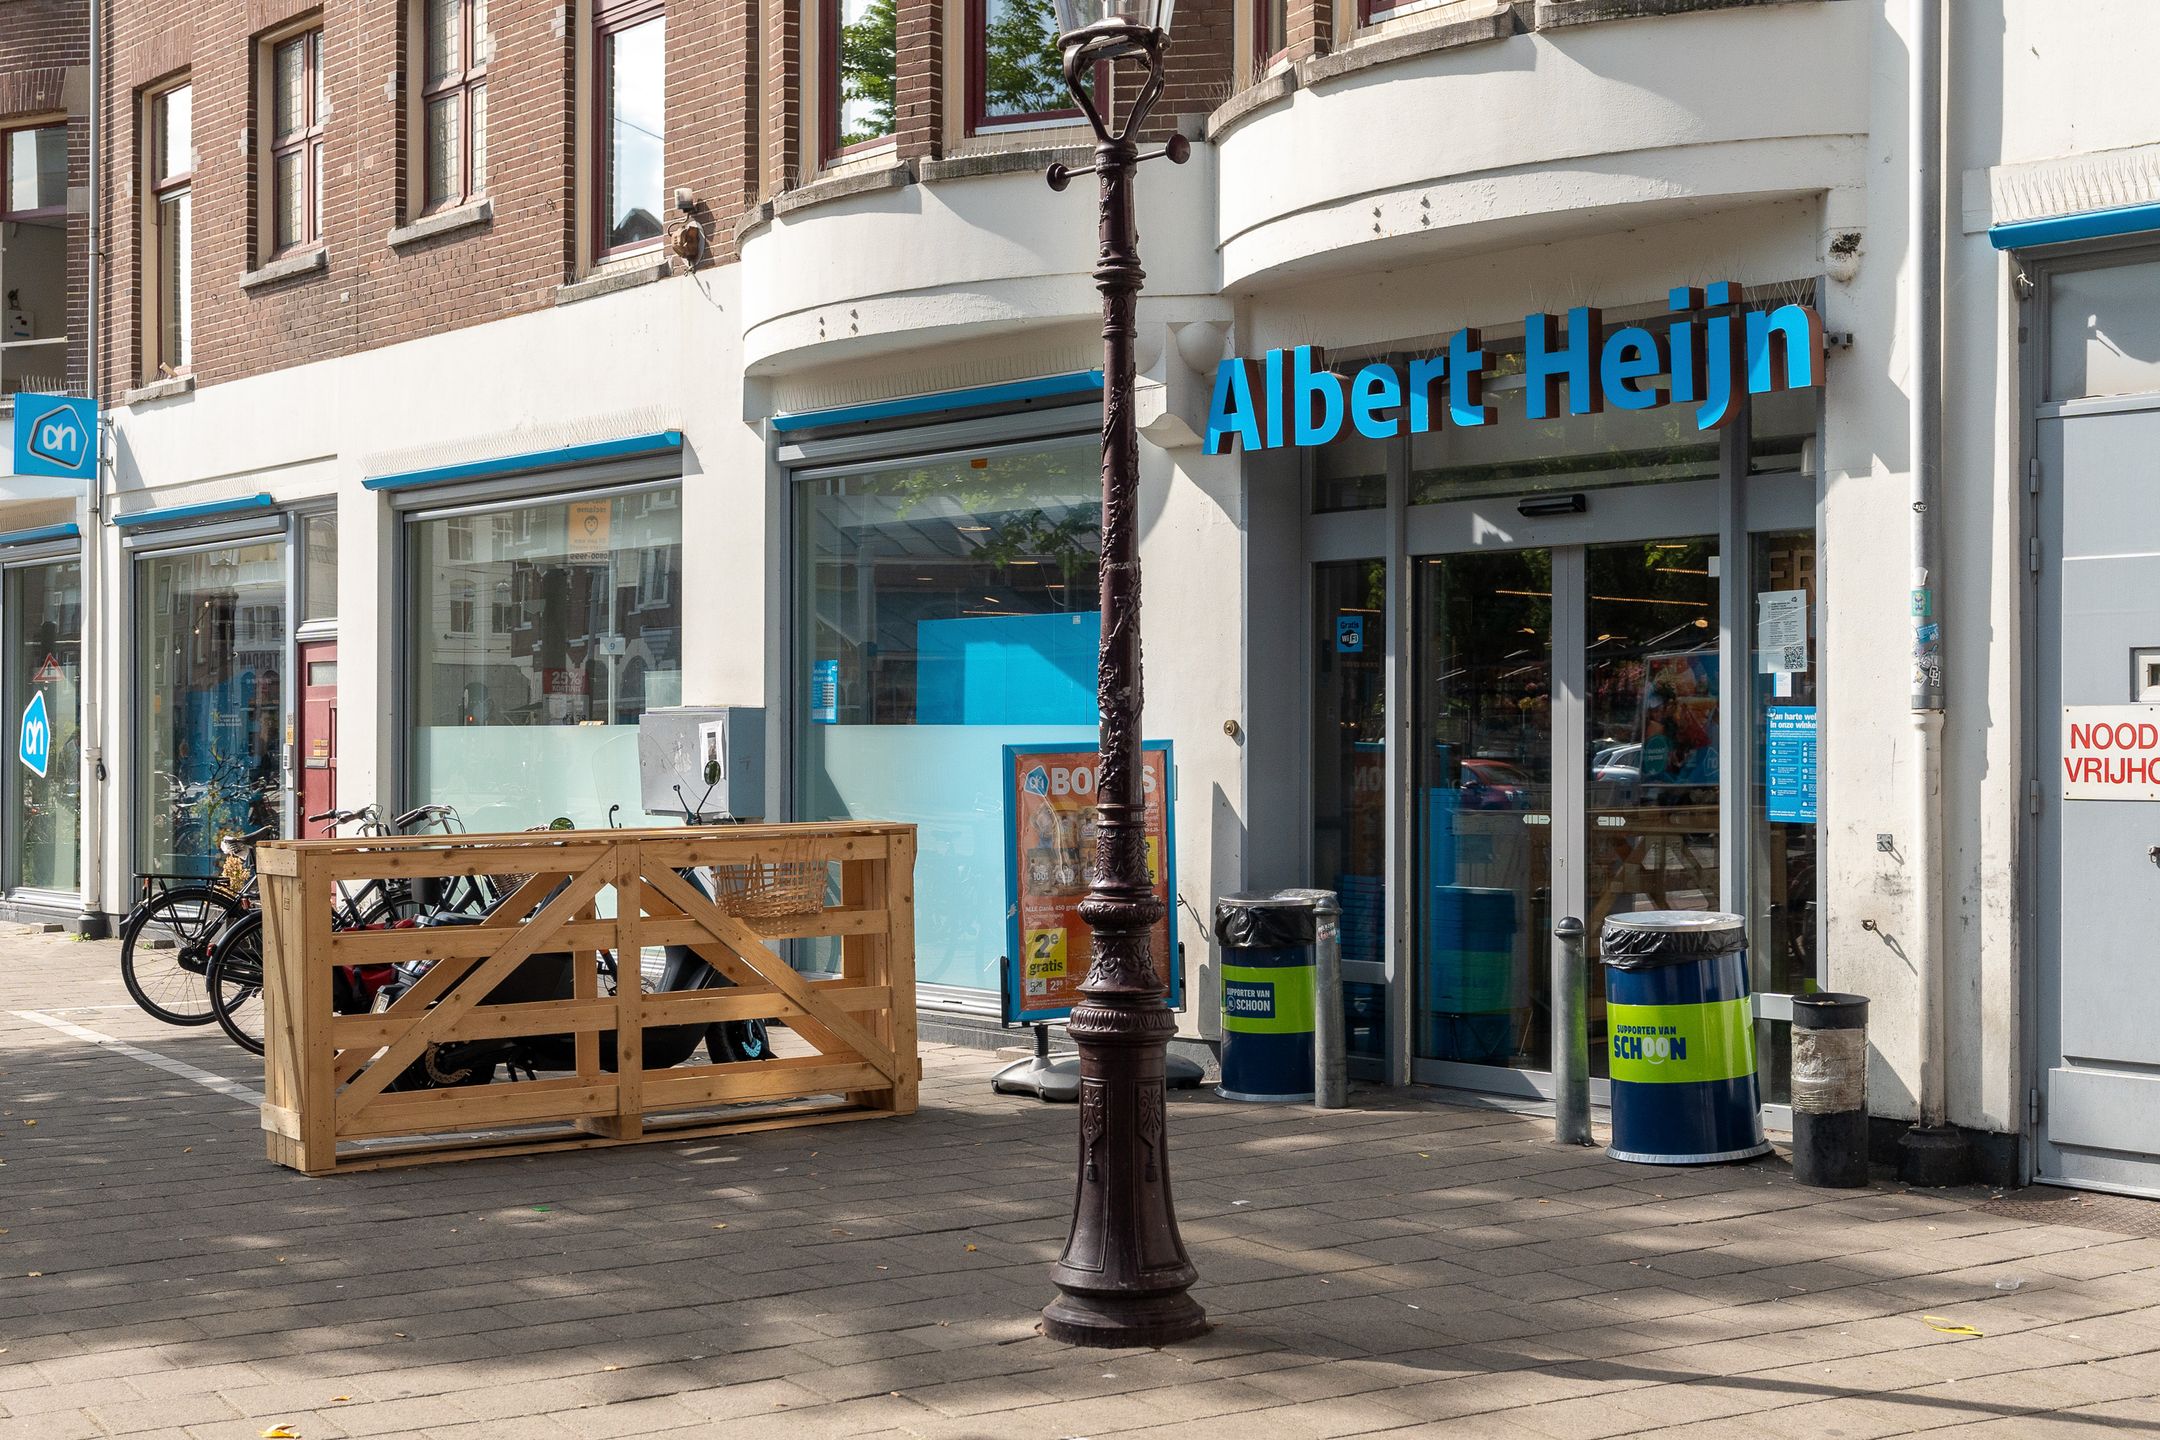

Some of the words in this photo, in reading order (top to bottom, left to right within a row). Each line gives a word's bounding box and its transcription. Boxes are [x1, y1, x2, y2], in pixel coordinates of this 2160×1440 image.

[1202, 327, 1497, 455] Albert
[1526, 281, 1822, 430] Heijn
[551, 671, 581, 685] 25%
[1784, 712, 1803, 720] harte
[1778, 721, 1794, 729] onze
[1051, 766, 1157, 795] BOS
[1029, 959, 1064, 976] gratis
[1226, 987, 1256, 998] SUPPORTER
[1256, 988, 1270, 998] VAN
[1236, 999, 1271, 1012] SCHOON
[1617, 1024, 1656, 1035] SUPPORTER
[1658, 1026, 1676, 1035] VAN
[1613, 1035, 1686, 1060] SCHOON
